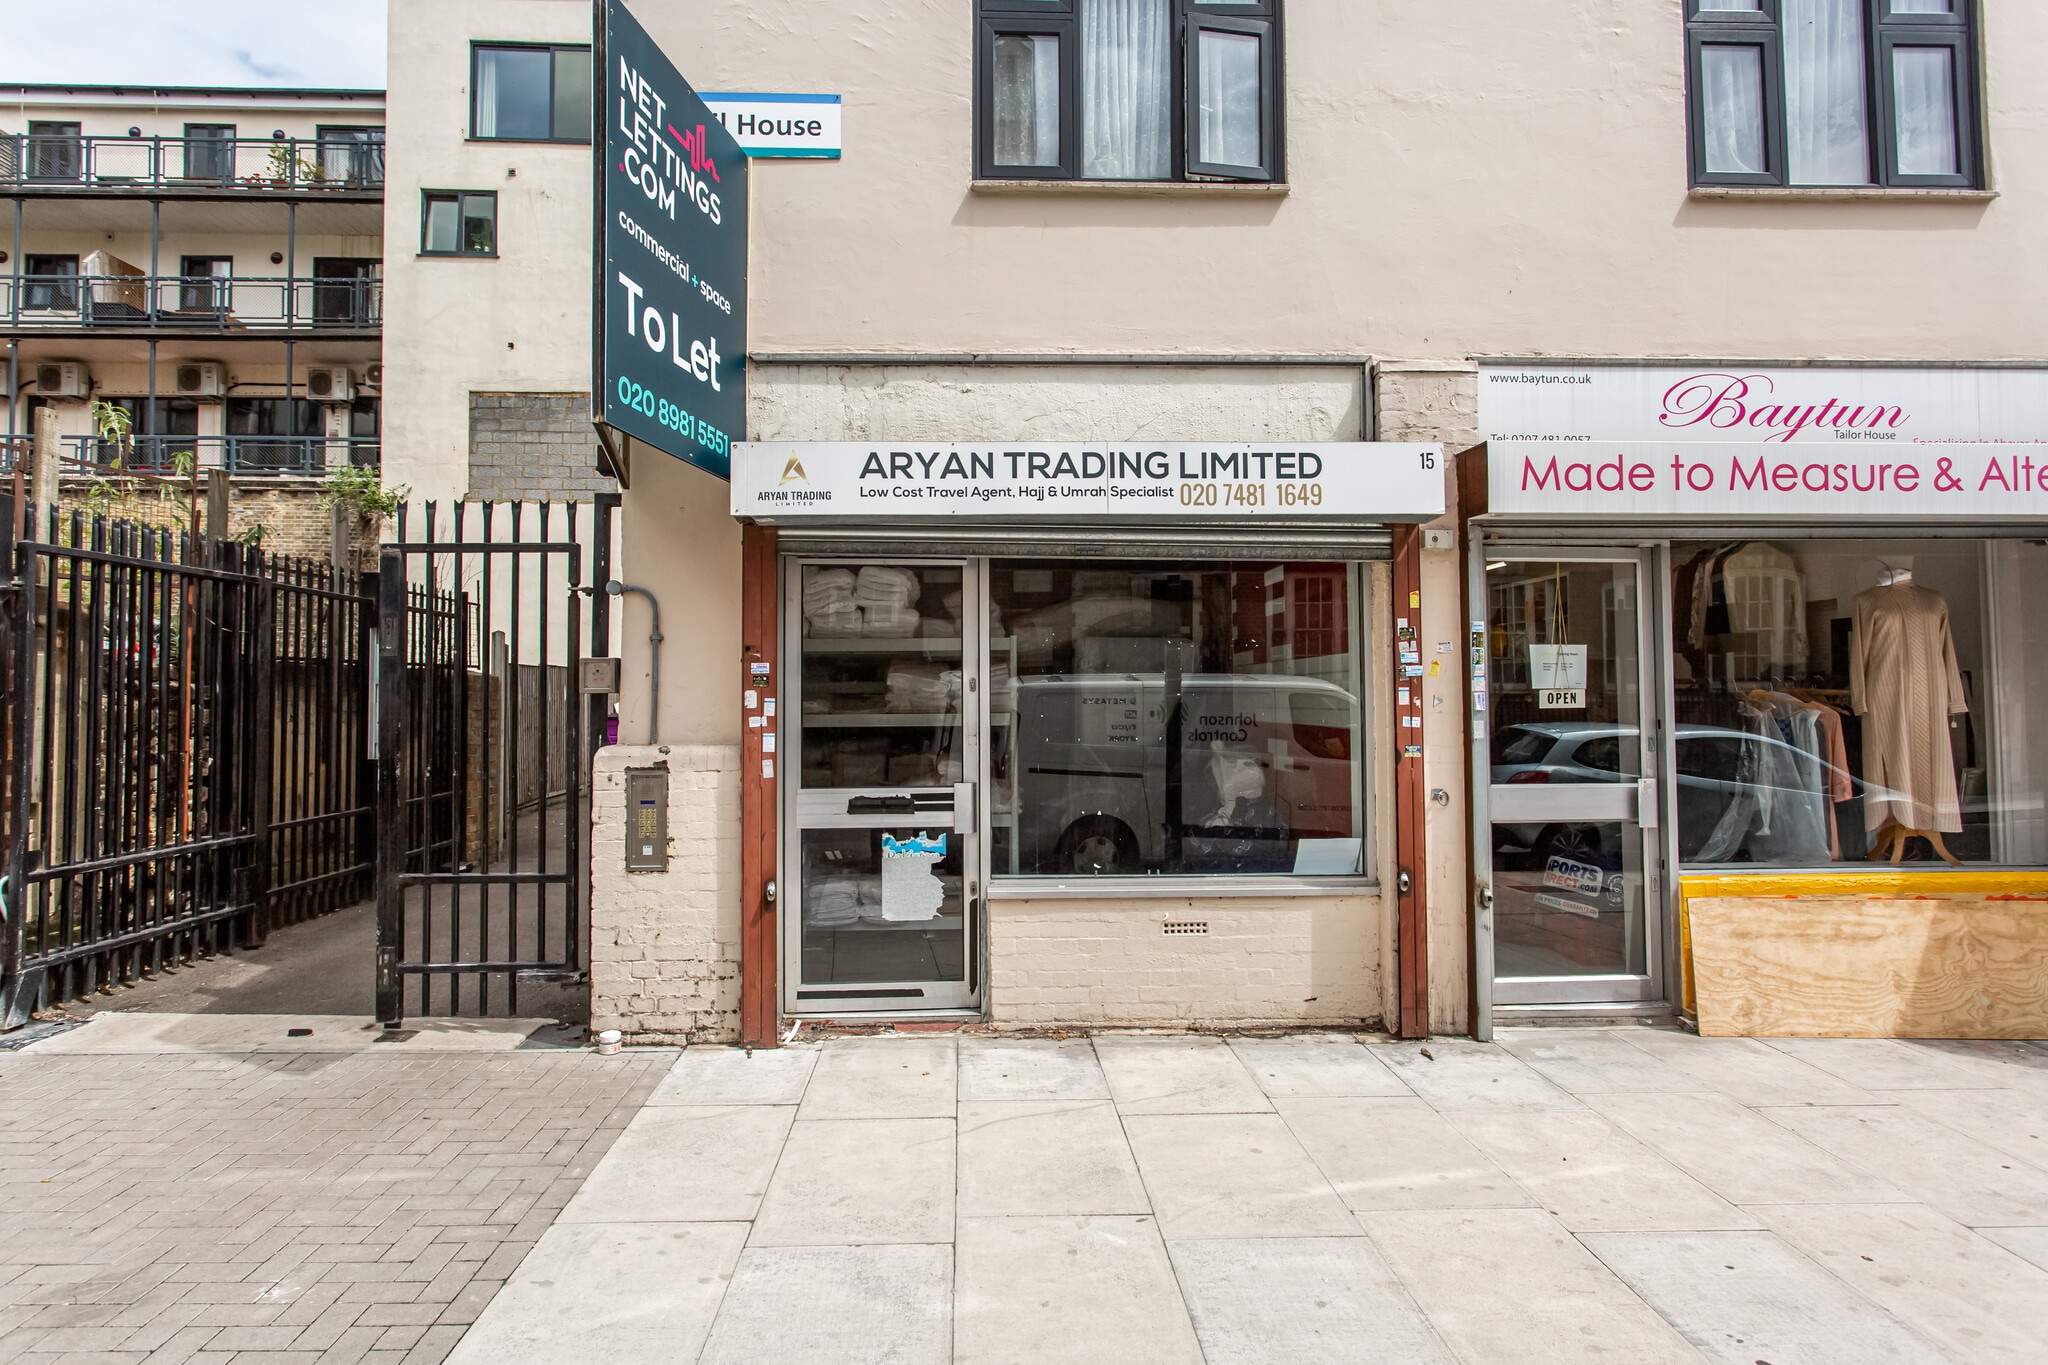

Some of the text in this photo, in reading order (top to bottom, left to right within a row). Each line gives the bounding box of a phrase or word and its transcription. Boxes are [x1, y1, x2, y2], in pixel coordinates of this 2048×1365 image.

[620, 54, 666, 130] NET
[737, 113, 822, 136] House
[620, 96, 721, 225] LETTINGS
[619, 147, 675, 221] .COM
[618, 211, 690, 283] commercial
[700, 280, 731, 315] space
[618, 271, 721, 392] To Let
[1489, 373, 1592, 386] www.baytun.co.uk
[618, 376, 729, 458] 020 8981 5551
[1658, 373, 1911, 442] Baytun
[1834, 429, 1896, 440] Tailor House
[859, 451, 1323, 479] ARYAN TRADING LIMITED
[1419, 452, 1435, 470] 15
[1522, 454, 1655, 492] Made
[1671, 454, 1714, 492] to
[1729, 455, 1920, 492] Measure
[1933, 456, 1964, 492] &
[757, 491, 832, 501] ARYAN TRADING
[859, 486, 1174, 501] Low Cost Travel Agent, Hajj & Umrah Specialist
[1180, 483, 1323, 506] 020 7481 1649
[1547, 692, 1577, 704] OPEN
